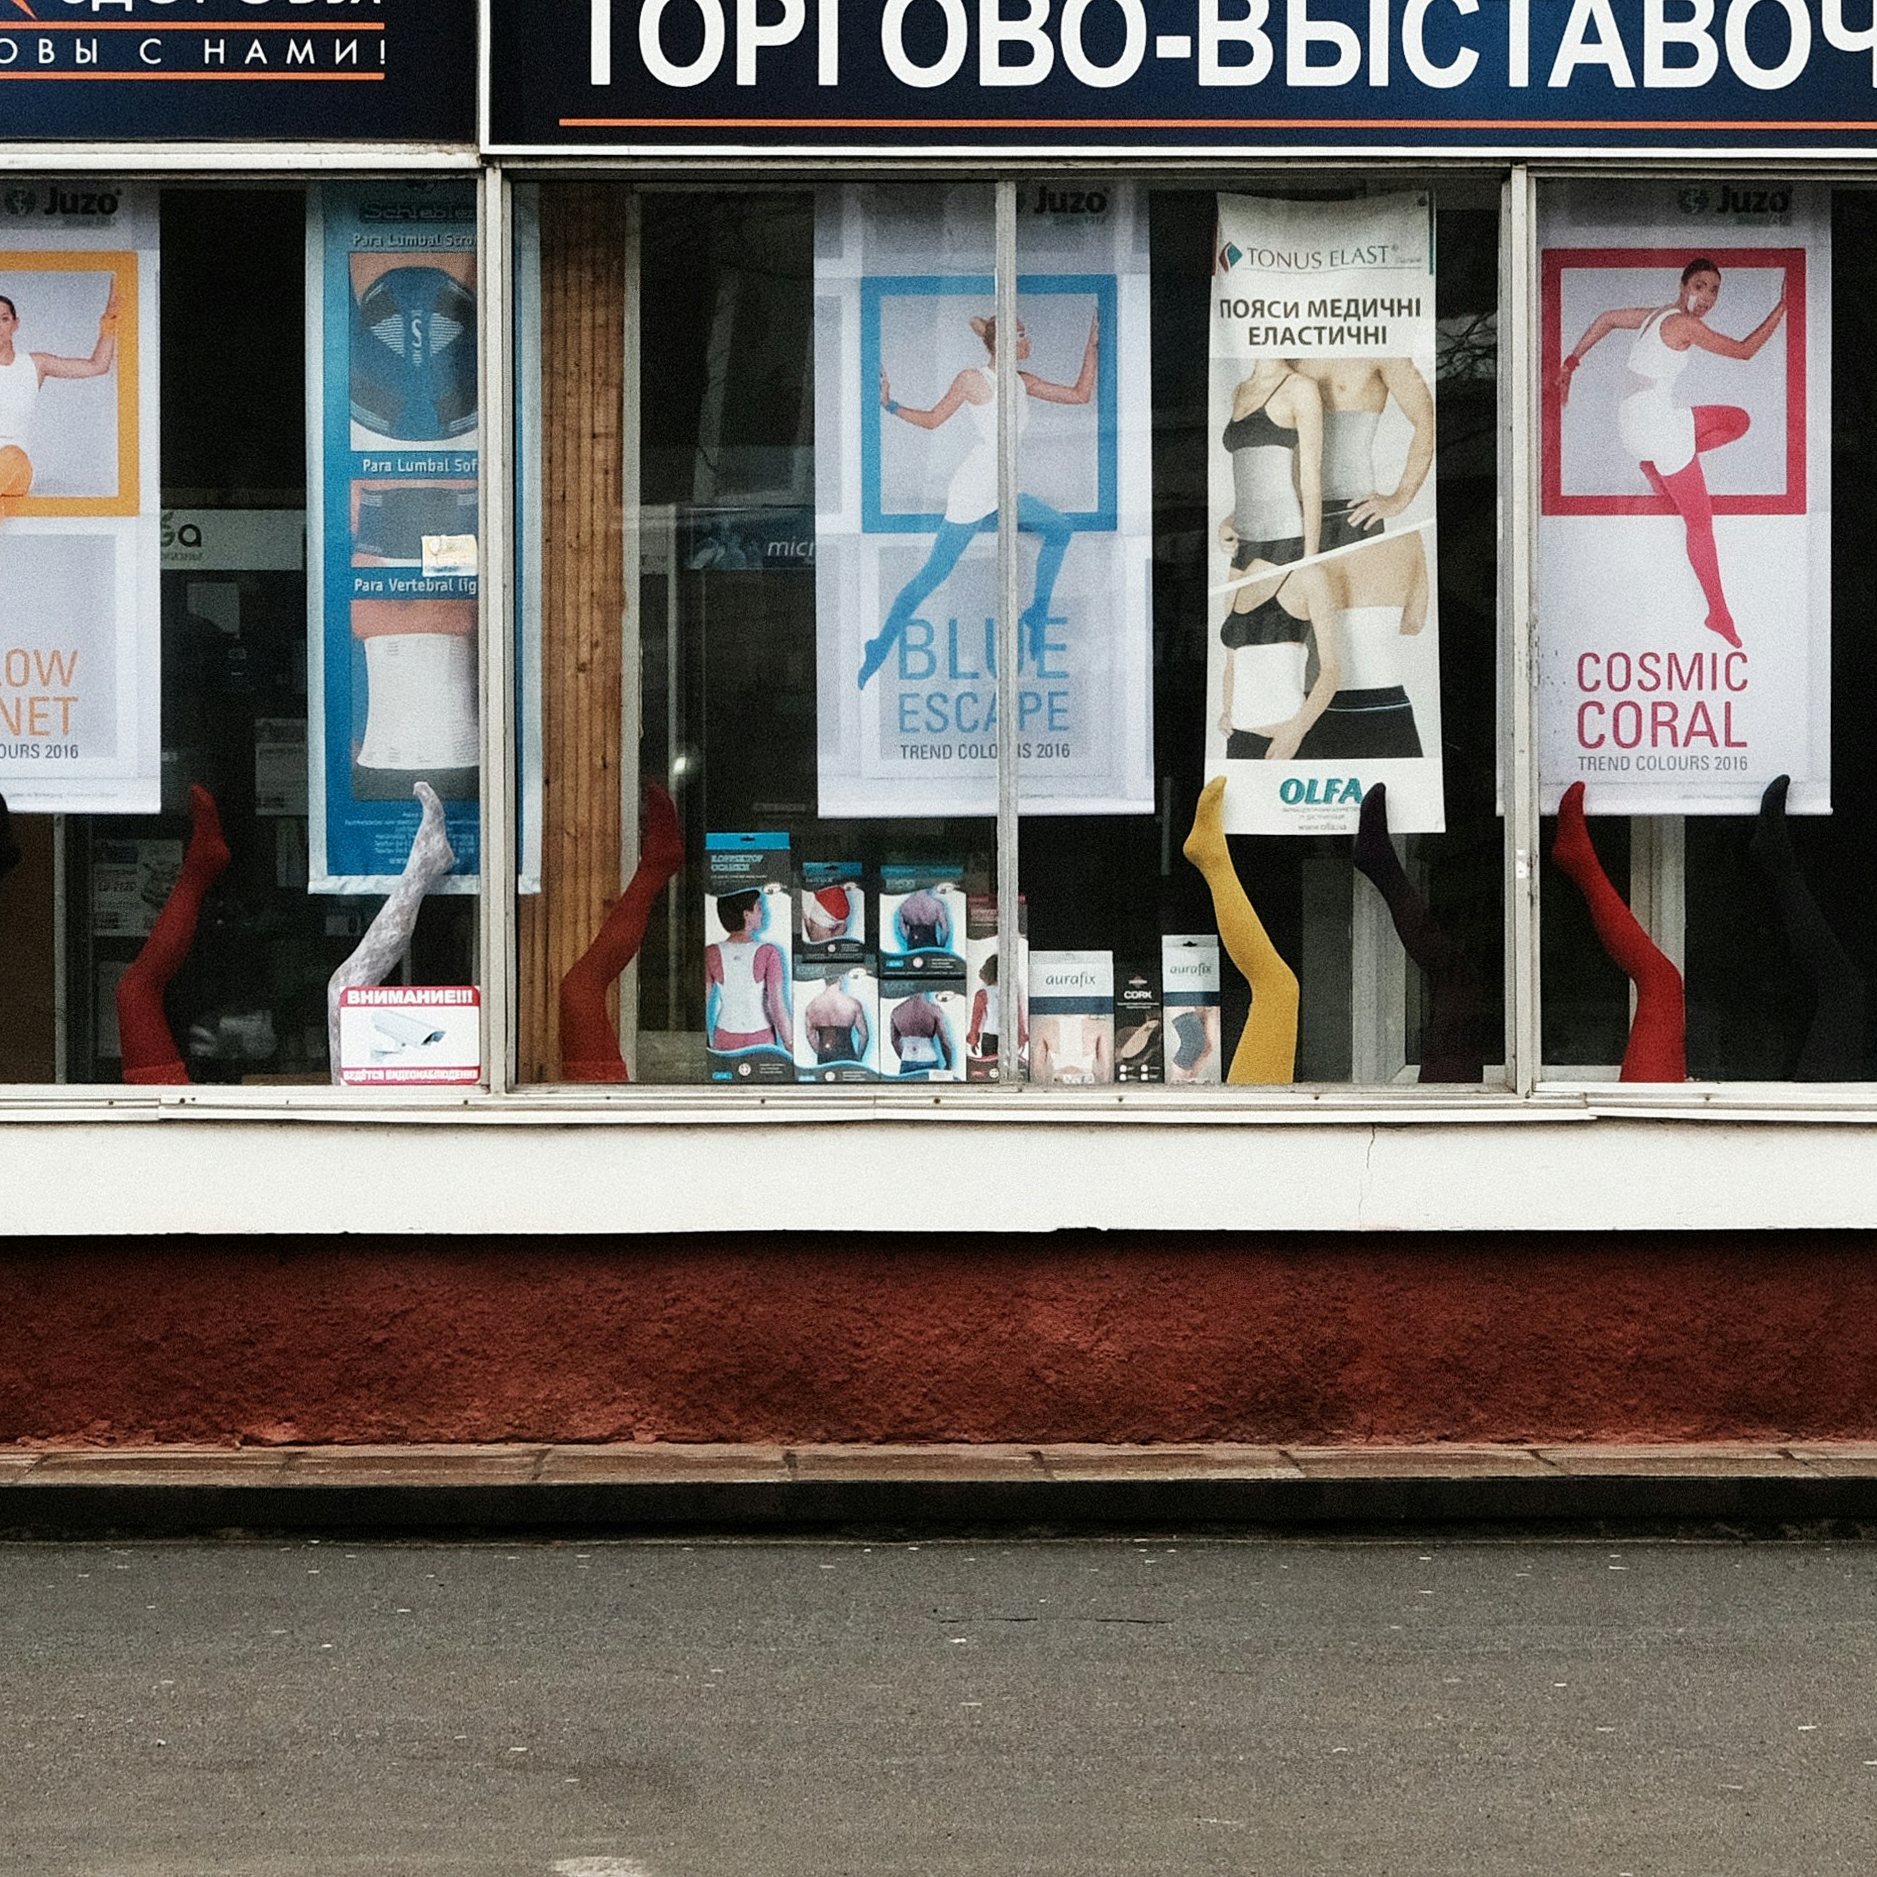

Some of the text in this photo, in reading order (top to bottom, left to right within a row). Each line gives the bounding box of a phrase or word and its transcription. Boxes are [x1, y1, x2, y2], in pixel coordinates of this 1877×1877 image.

[140, 36, 163, 67] С
[205, 36, 387, 67] НАМИ!
[353, 233, 384, 247] Para
[1246, 246, 1322, 270] TONUS
[1329, 245, 1390, 267] ELAST
[1219, 297, 1421, 322] ПОЯСИ МЕДИЧНІ
[1248, 325, 1388, 346] ЕЛАСТИЧНІ
[362, 459, 393, 473] Para
[397, 458, 450, 473] Lumbal
[354, 579, 384, 592] Para
[388, 578, 454, 593] Vertebral
[1577, 652, 1748, 692] COSMIC
[1577, 701, 1748, 749] CORAL
[44, 744, 79, 759] 2016
[900, 744, 953, 760] TREND
[1037, 743, 1071, 759] 2016
[1578, 756, 1748, 771] TREND COLOURS 2016
[1279, 778, 1363, 805] OLFA
[1169, 962, 1212, 977] aurafix
[1045, 971, 1096, 988] aurafix
